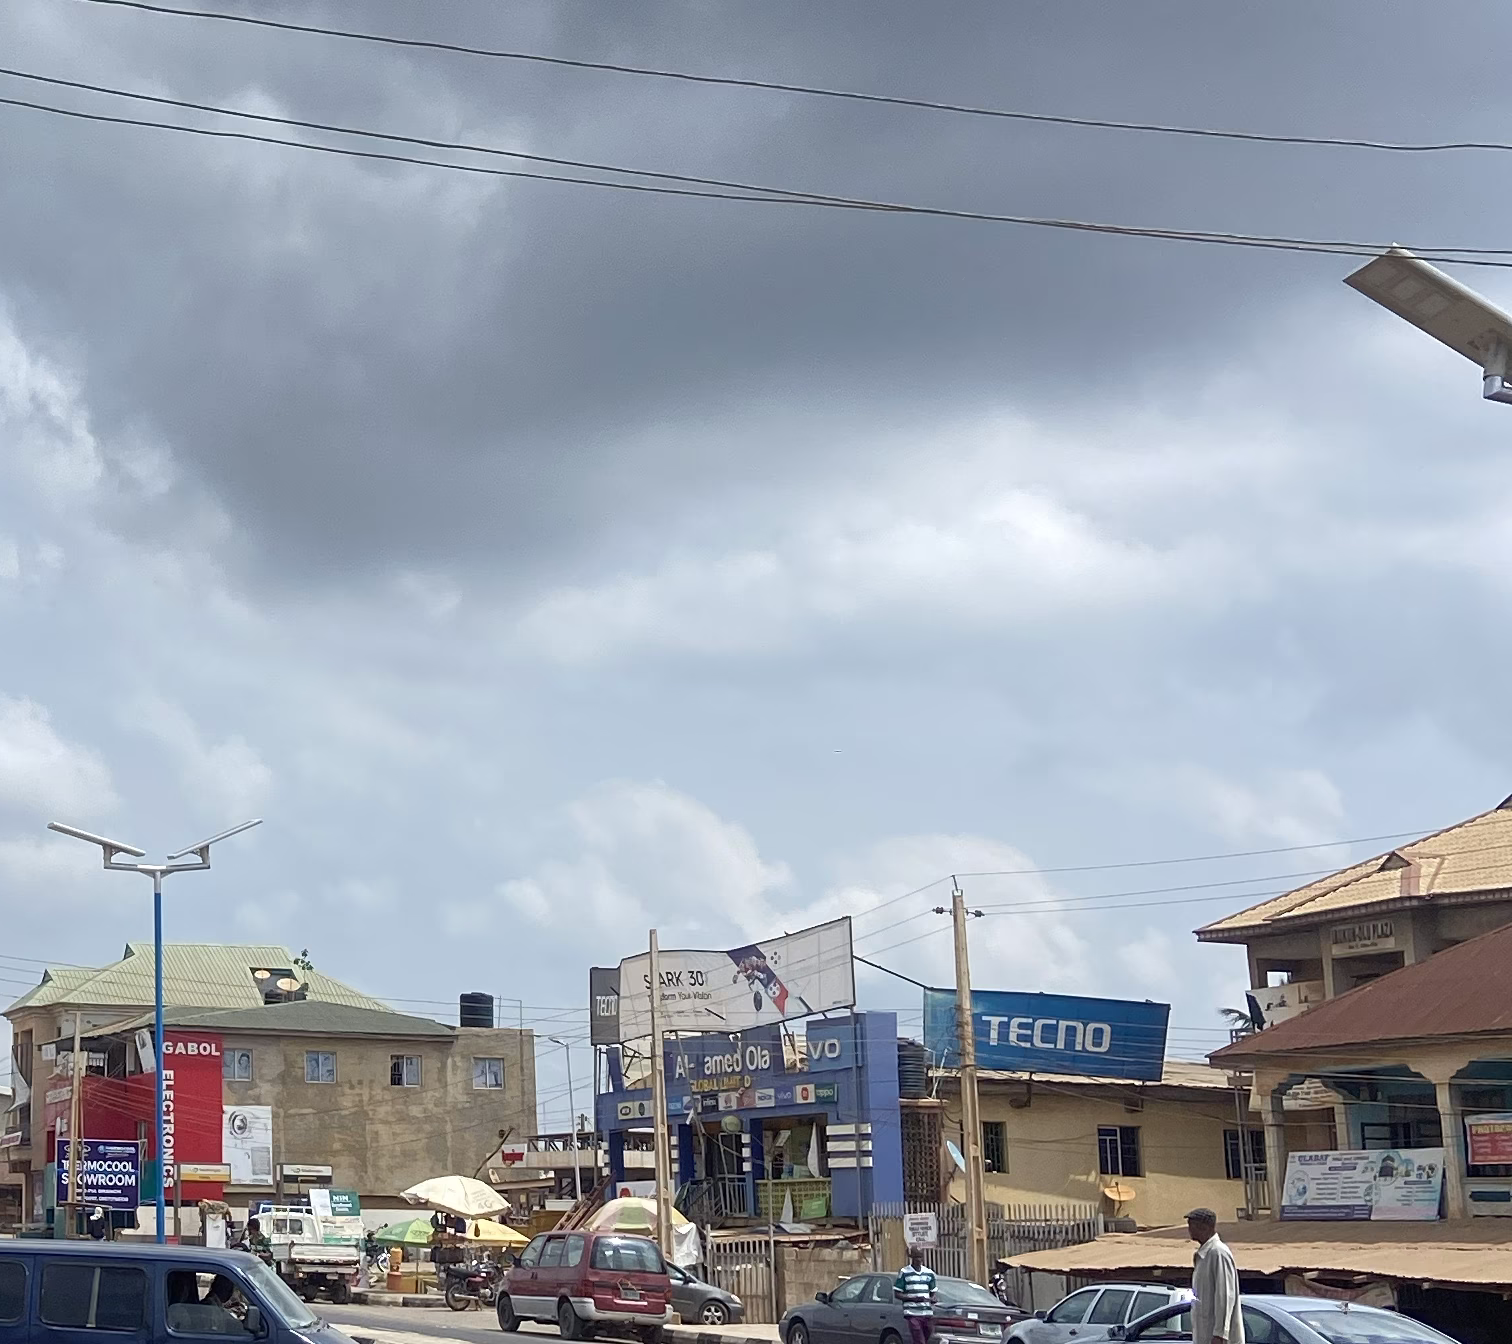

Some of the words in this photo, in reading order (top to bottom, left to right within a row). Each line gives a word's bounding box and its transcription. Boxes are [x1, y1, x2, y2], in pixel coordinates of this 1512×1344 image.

[643, 970, 683, 990] SARK
[982, 1015, 1112, 1053] TECNO
[162, 1042, 221, 1056] GABOL
[745, 1045, 771, 1071] Ola
[162, 1069, 175, 1189] ELECTRONICS
[61, 1173, 136, 1187] SOWROOM
